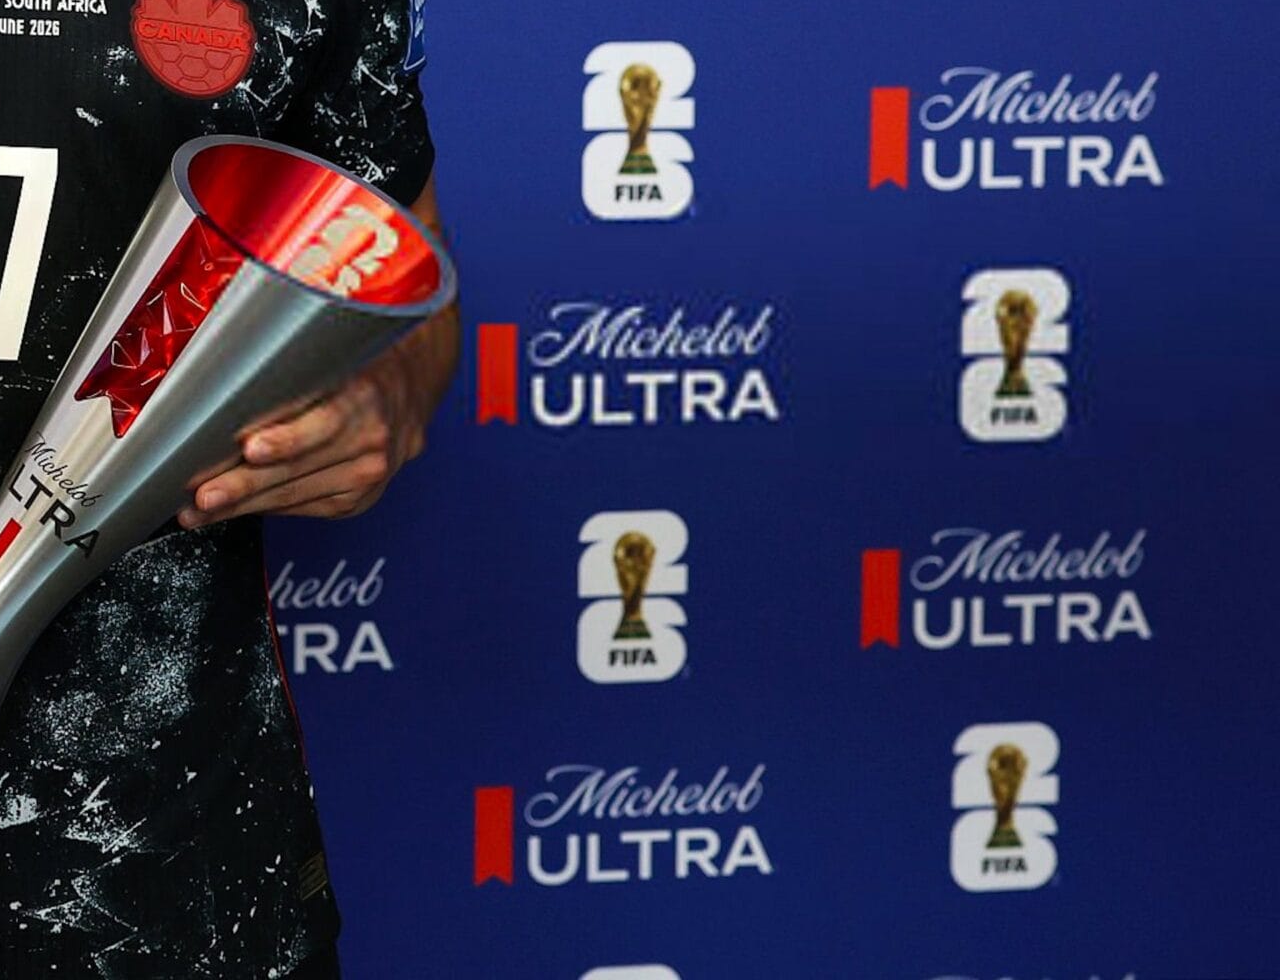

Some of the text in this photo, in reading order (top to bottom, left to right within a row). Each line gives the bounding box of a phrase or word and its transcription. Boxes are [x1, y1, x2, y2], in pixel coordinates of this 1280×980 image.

[29, 19, 60, 37] 2026
[137, 19, 249, 53] CANADA
[921, 68, 1157, 130] Michelob
[922, 135, 1162, 190] ULTRA
[615, 184, 662, 202] FIFA
[529, 304, 771, 366] Michelob
[532, 370, 778, 426] ULTRA
[990, 407, 1038, 424] FIFA
[8, 463, 101, 559] LTRA
[269, 558, 385, 610] helob
[911, 529, 1144, 590] Michelob
[914, 591, 1150, 649] ULTRA
[609, 648, 657, 667] FIFA
[527, 765, 764, 826] Michelob
[528, 826, 771, 885] ULTRA
[982, 857, 1027, 873] FIFA
